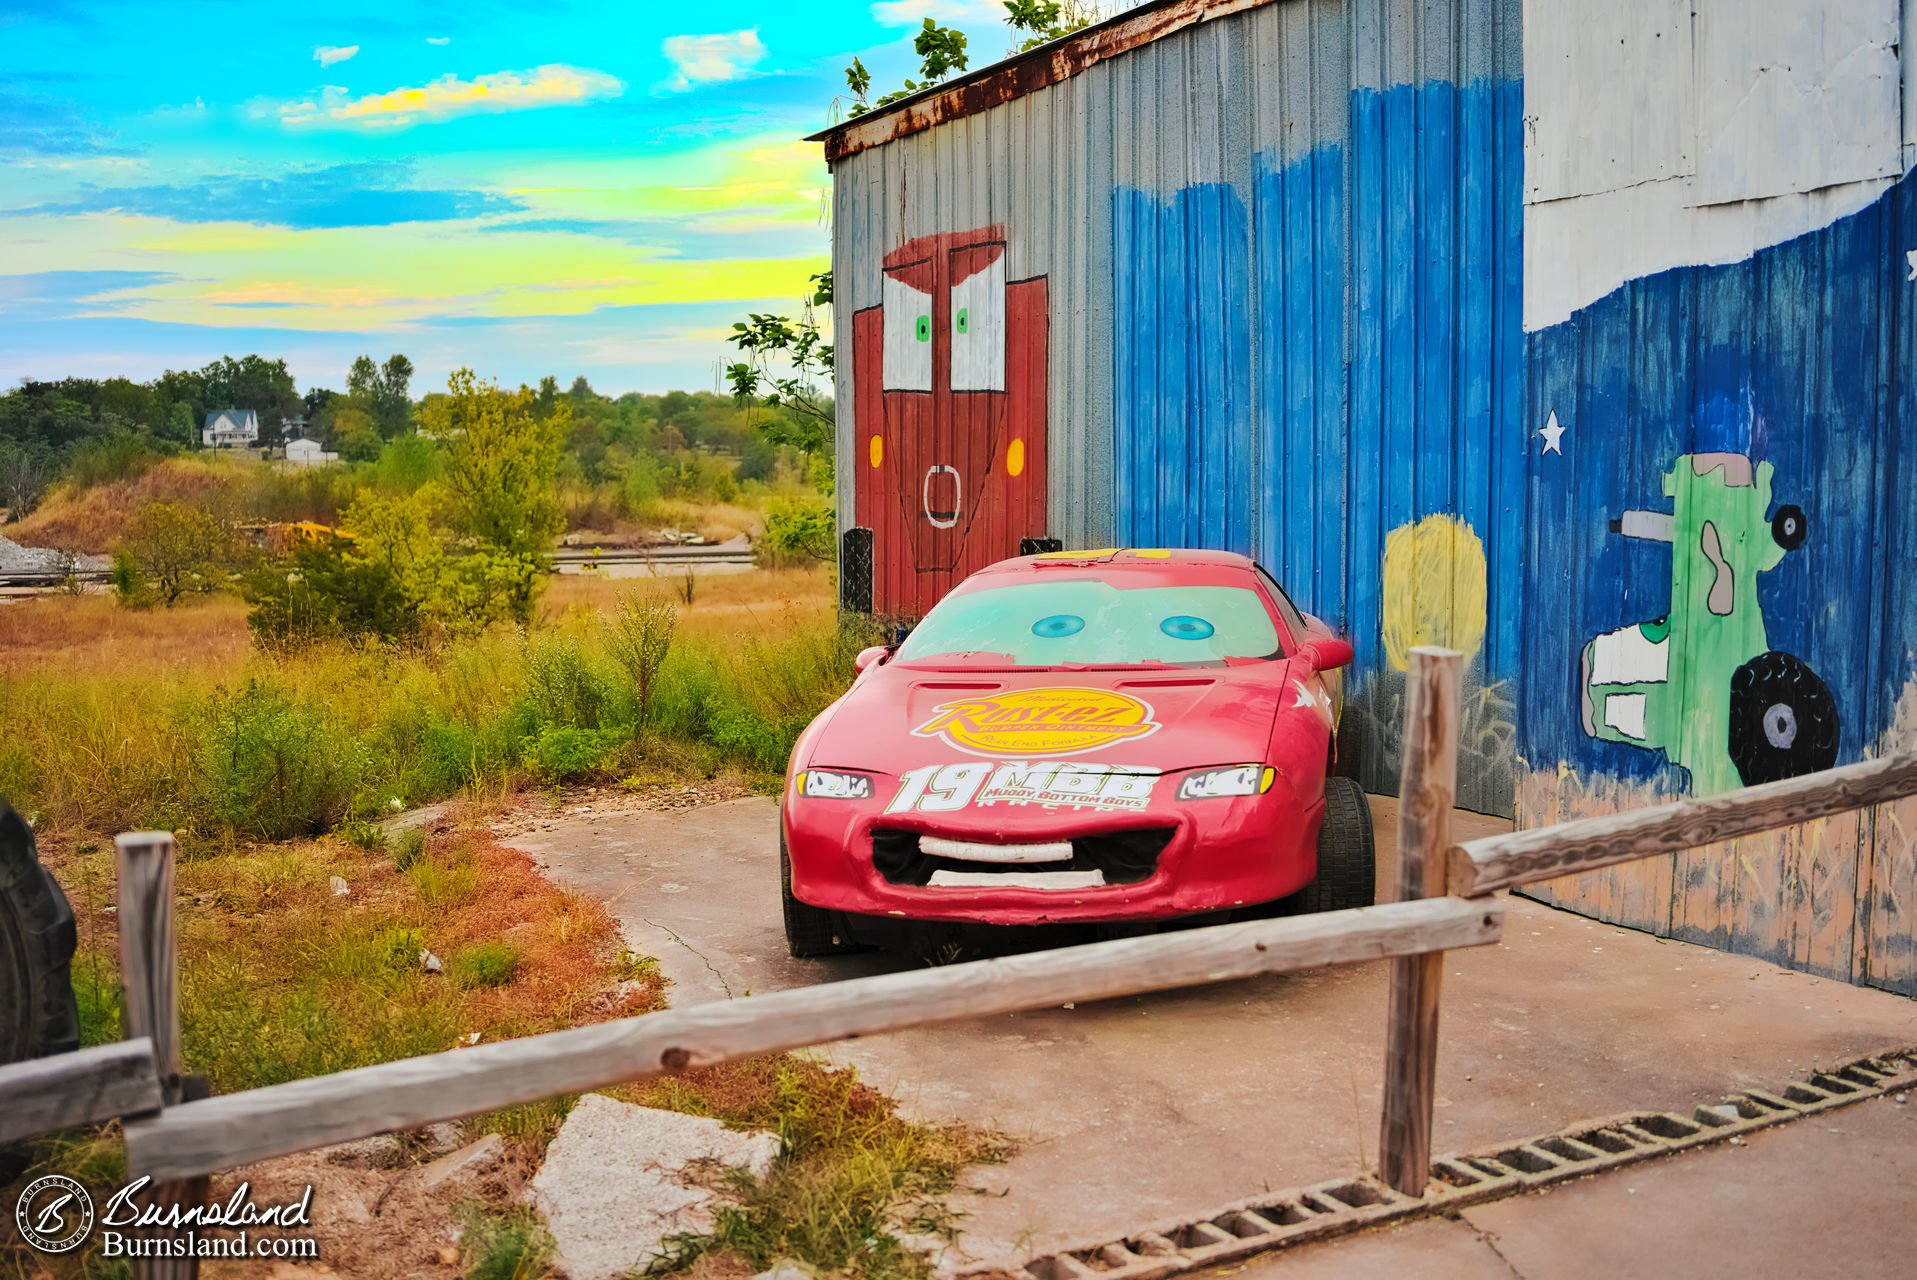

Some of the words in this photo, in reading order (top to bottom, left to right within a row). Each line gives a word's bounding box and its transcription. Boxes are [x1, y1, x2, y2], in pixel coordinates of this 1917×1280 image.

[883, 762, 994, 815] 19
[980, 761, 1161, 798] MBB
[984, 788, 1035, 797] MUDDY
[1038, 791, 1101, 802] BOTTOM
[1103, 797, 1143, 807] BOYS
